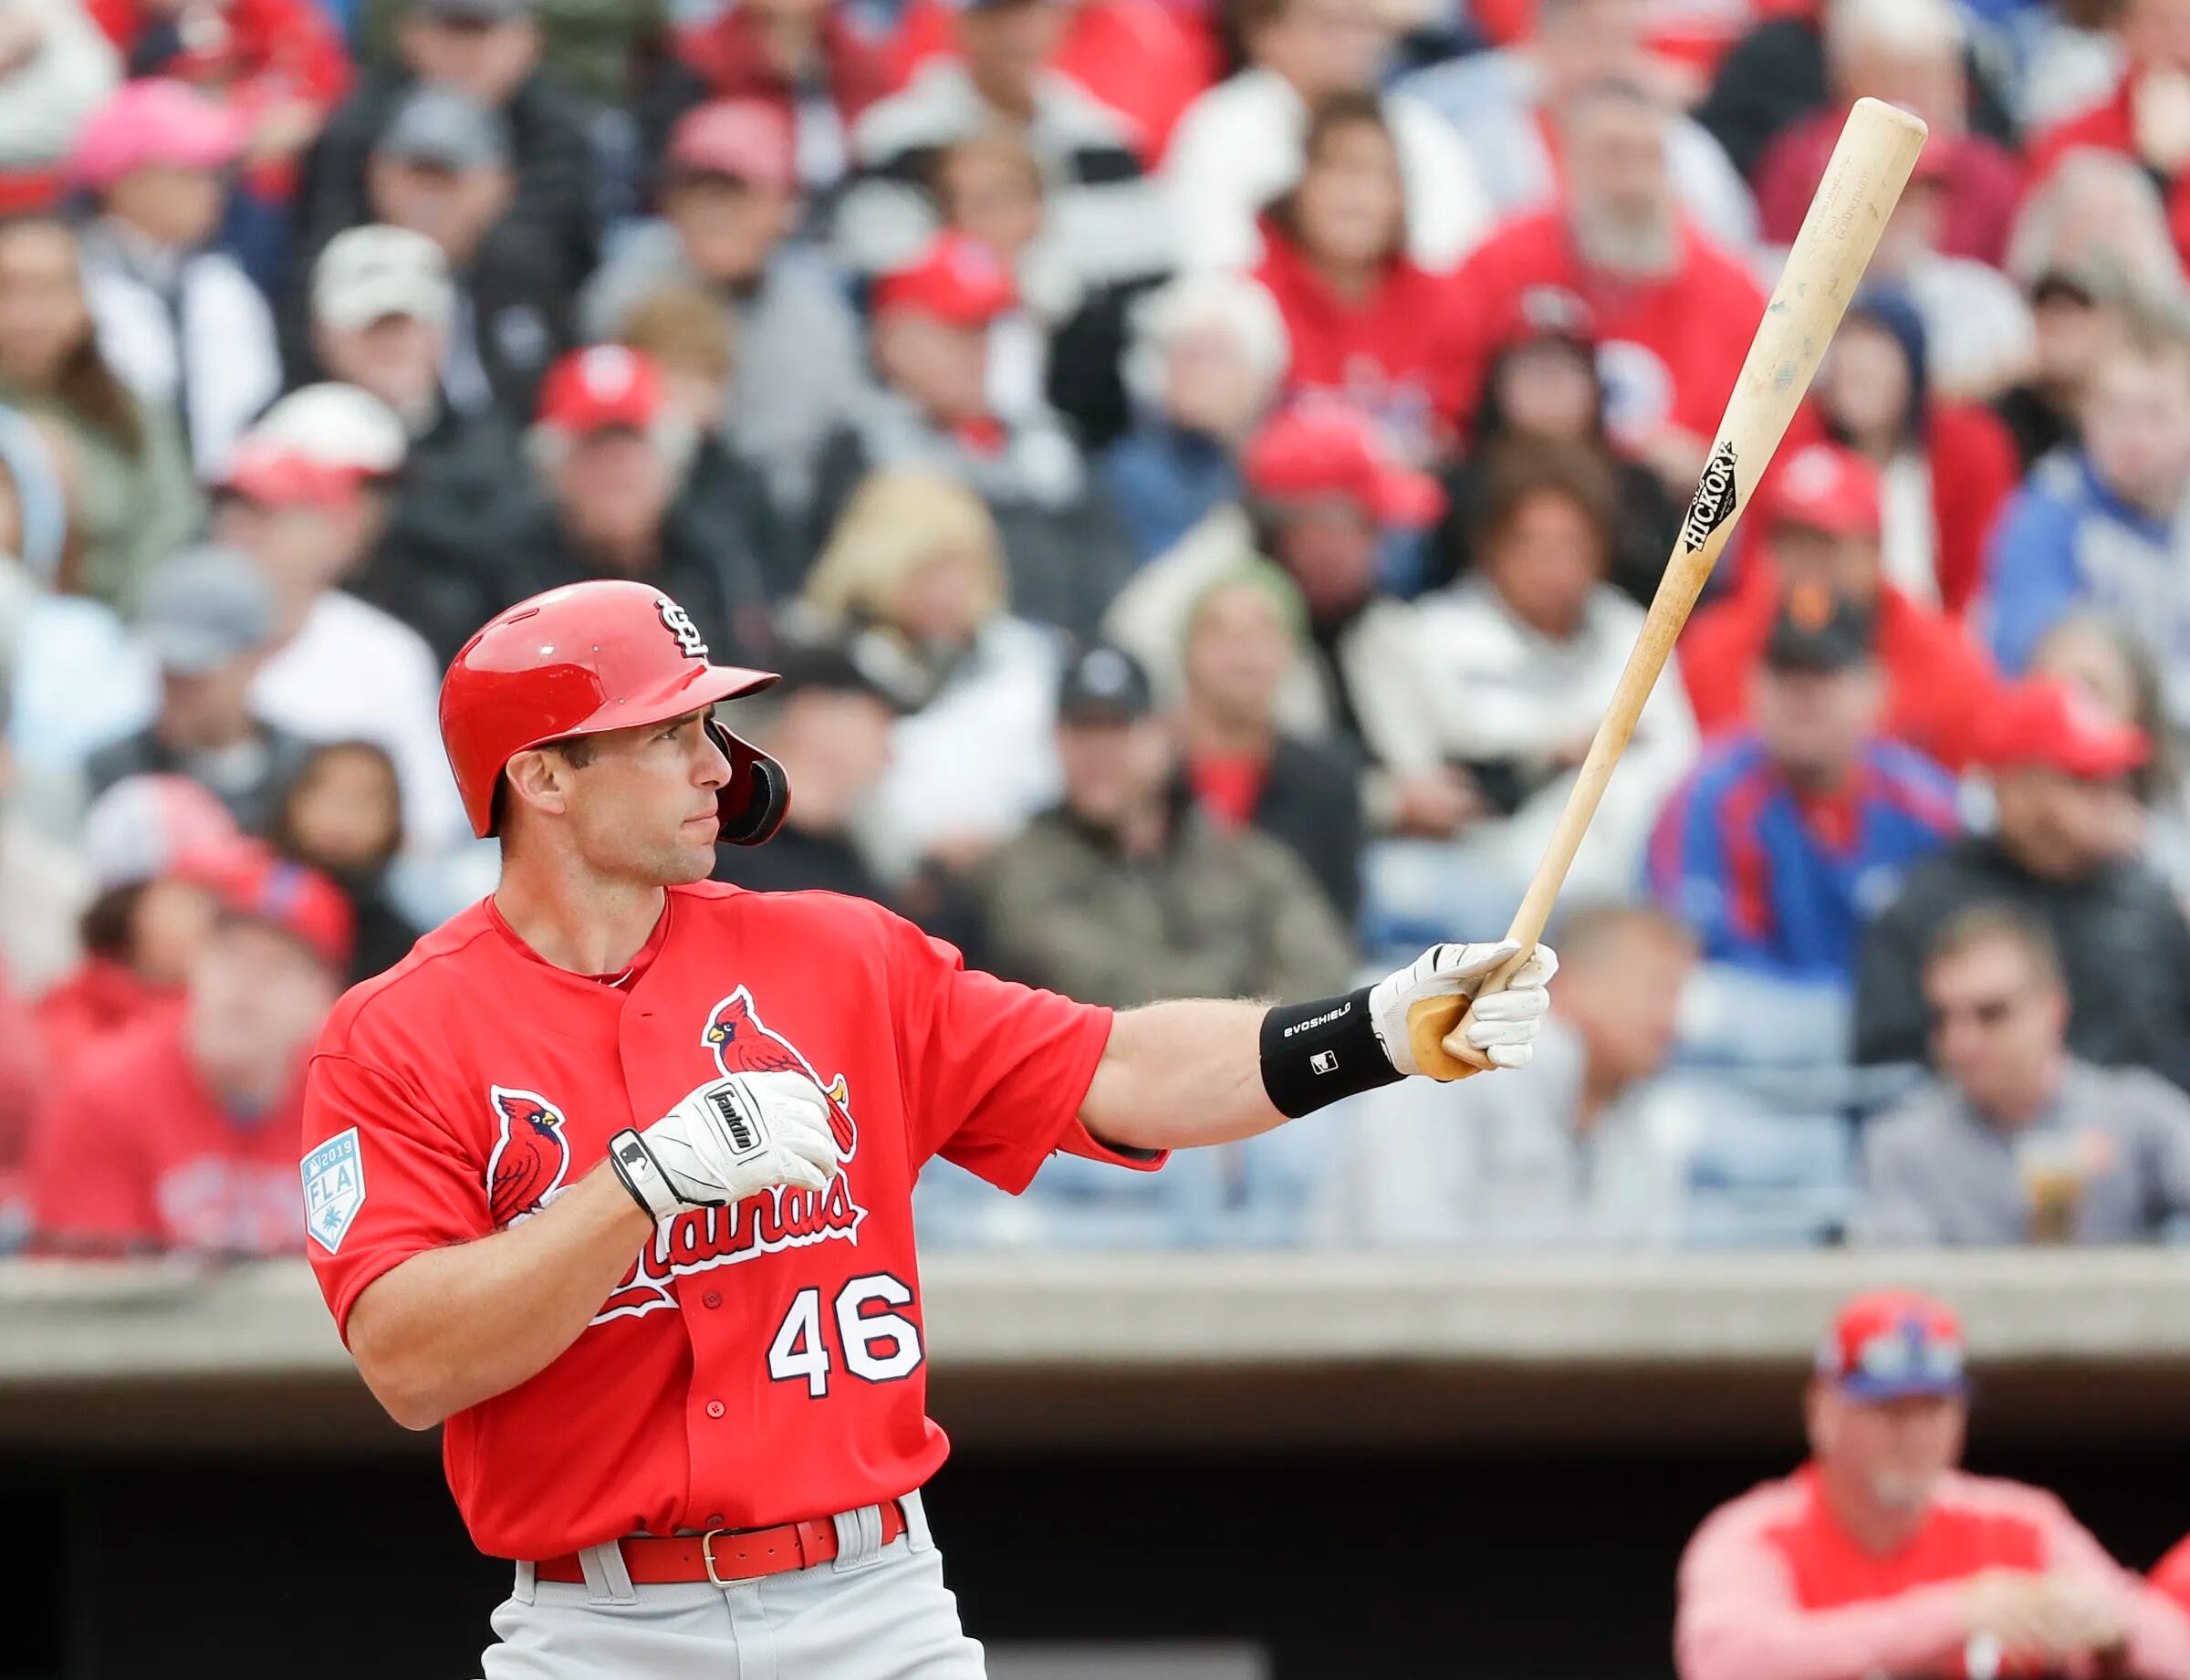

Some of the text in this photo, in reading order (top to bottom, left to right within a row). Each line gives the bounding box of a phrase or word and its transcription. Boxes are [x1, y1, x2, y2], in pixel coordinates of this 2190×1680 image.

[1684, 442, 1737, 552] HICKORY
[708, 1090, 752, 1149] Franklin
[321, 1140, 352, 1166] 2019
[310, 1164, 352, 1210] FLA
[766, 1271, 925, 1399] 46
